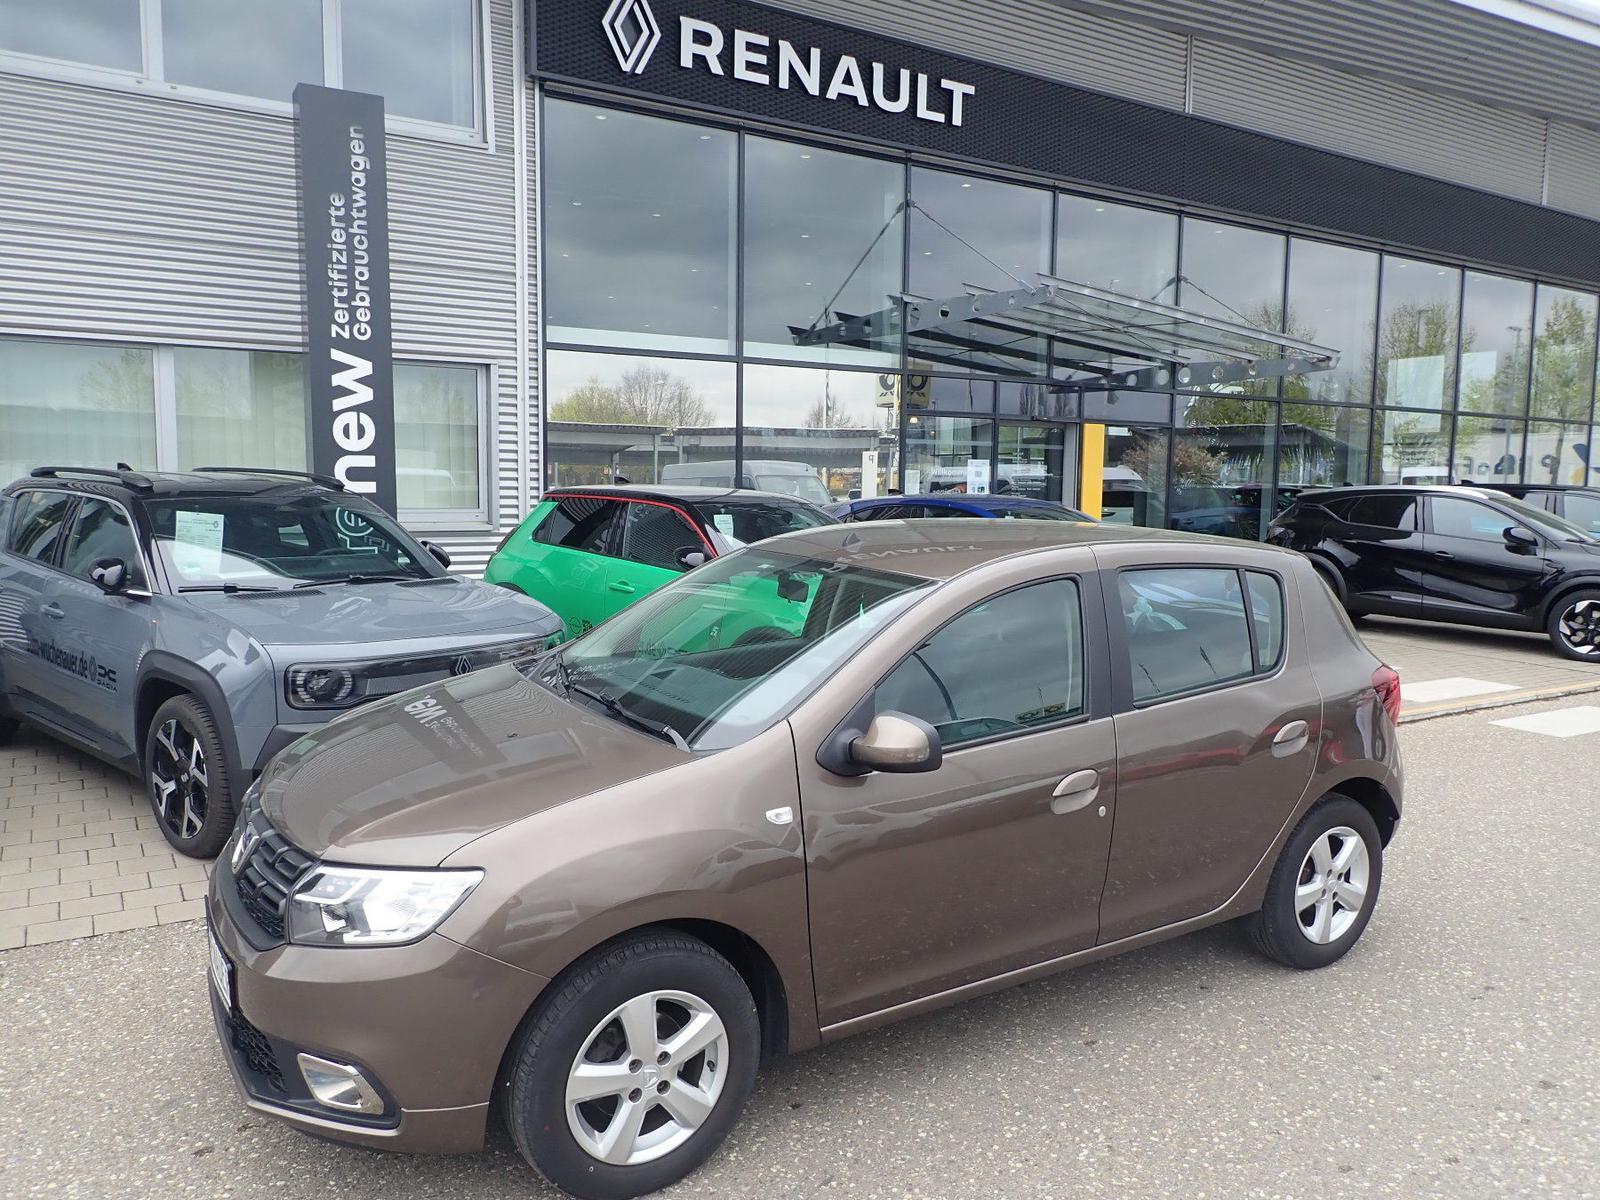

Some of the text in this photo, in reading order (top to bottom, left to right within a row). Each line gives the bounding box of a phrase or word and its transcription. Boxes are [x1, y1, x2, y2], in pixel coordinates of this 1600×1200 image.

[679, 15, 976, 127] RENAULT
[327, 192, 350, 340] Zertifizierte
[349, 125, 372, 341] Gebrauchtwagen
